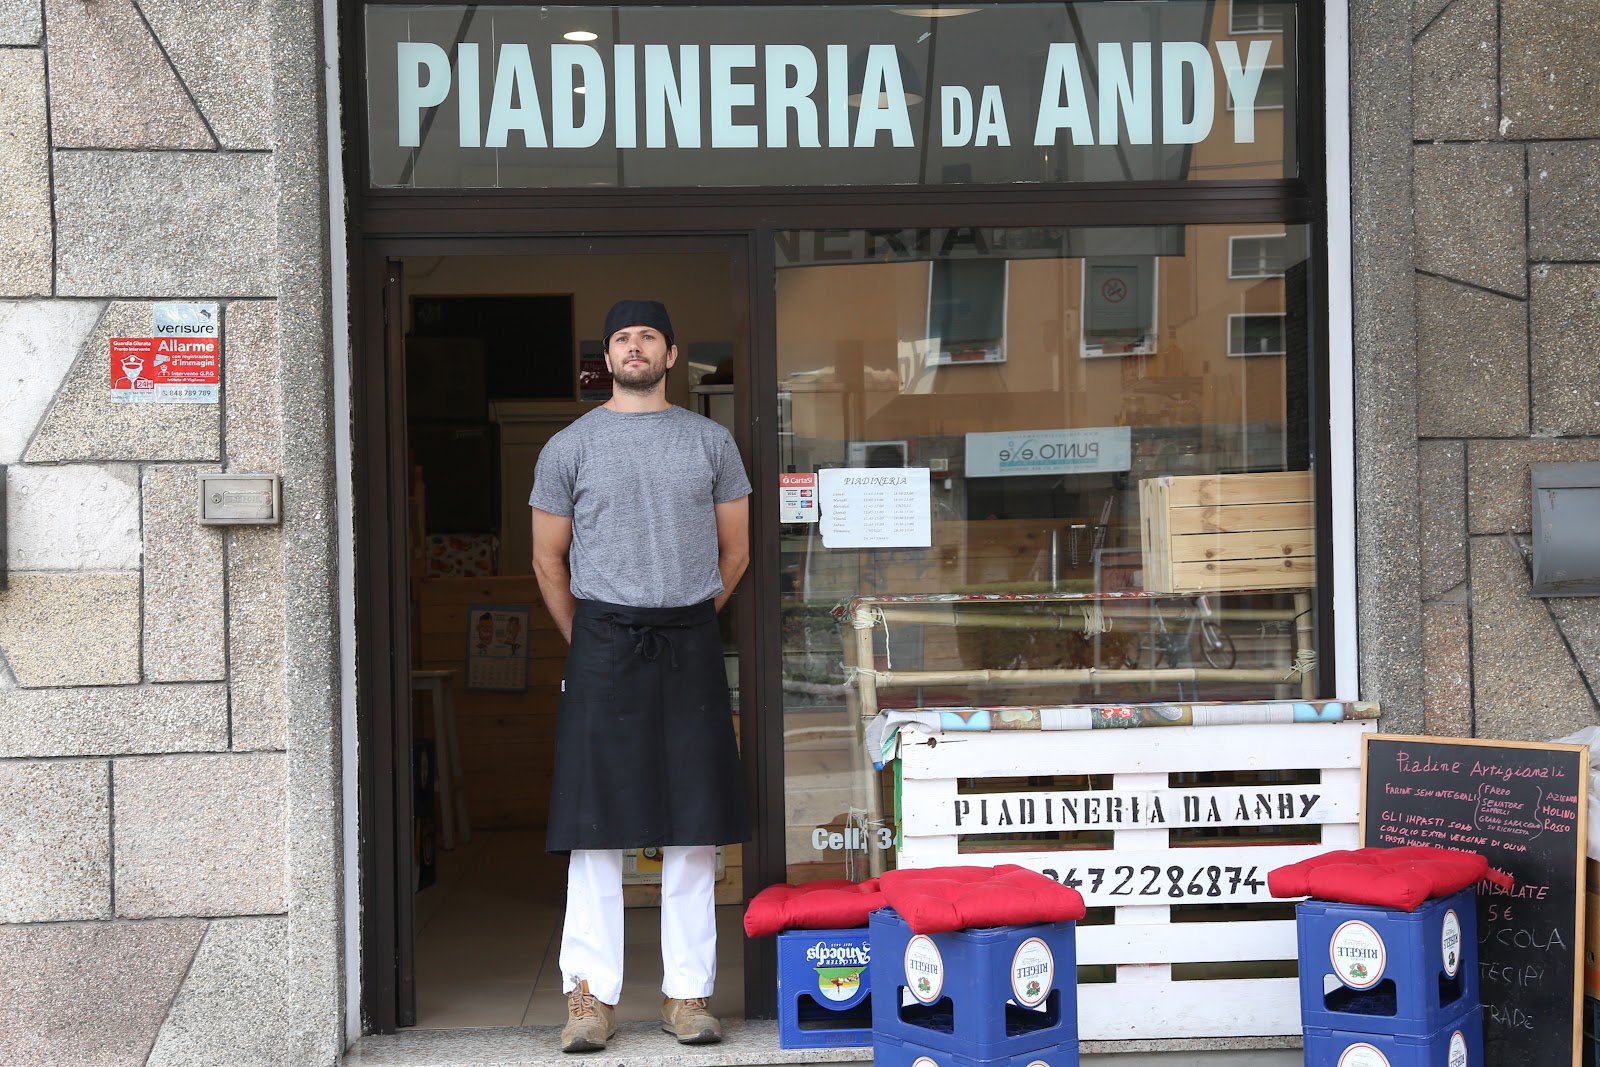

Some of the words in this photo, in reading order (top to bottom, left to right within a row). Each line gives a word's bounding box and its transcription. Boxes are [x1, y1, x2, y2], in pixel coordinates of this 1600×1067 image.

[396, 41, 916, 150] PIADINERIA
[940, 84, 1011, 149] DA
[1033, 40, 1273, 147] ANDY
[157, 325, 214, 334] verisure
[158, 340, 215, 352] Allarme
[844, 476, 908, 486] PIADINERIA
[1396, 751, 1461, 773] Piadine
[1470, 761, 1565, 781] Artigianali
[1385, 783, 1413, 795] FARINE
[1484, 785, 1511, 796] FARRO
[954, 795, 1165, 827] PIADINERIA
[1183, 795, 1222, 823] DA
[1481, 798, 1524, 810] SENATORE
[1542, 805, 1576, 820] MOLINO
[1406, 814, 1445, 826] IMPASTI
[1421, 830, 1446, 839] EXTRA
[1450, 834, 1488, 845] VERGINE
[1503, 841, 1528, 852] OLIVA
[1488, 904, 1498, 922] 5
[1337, 946, 1379, 959] RIEGELE
[910, 958, 938, 974] RIEGELE
[1017, 962, 1048, 979] RIEGELE
